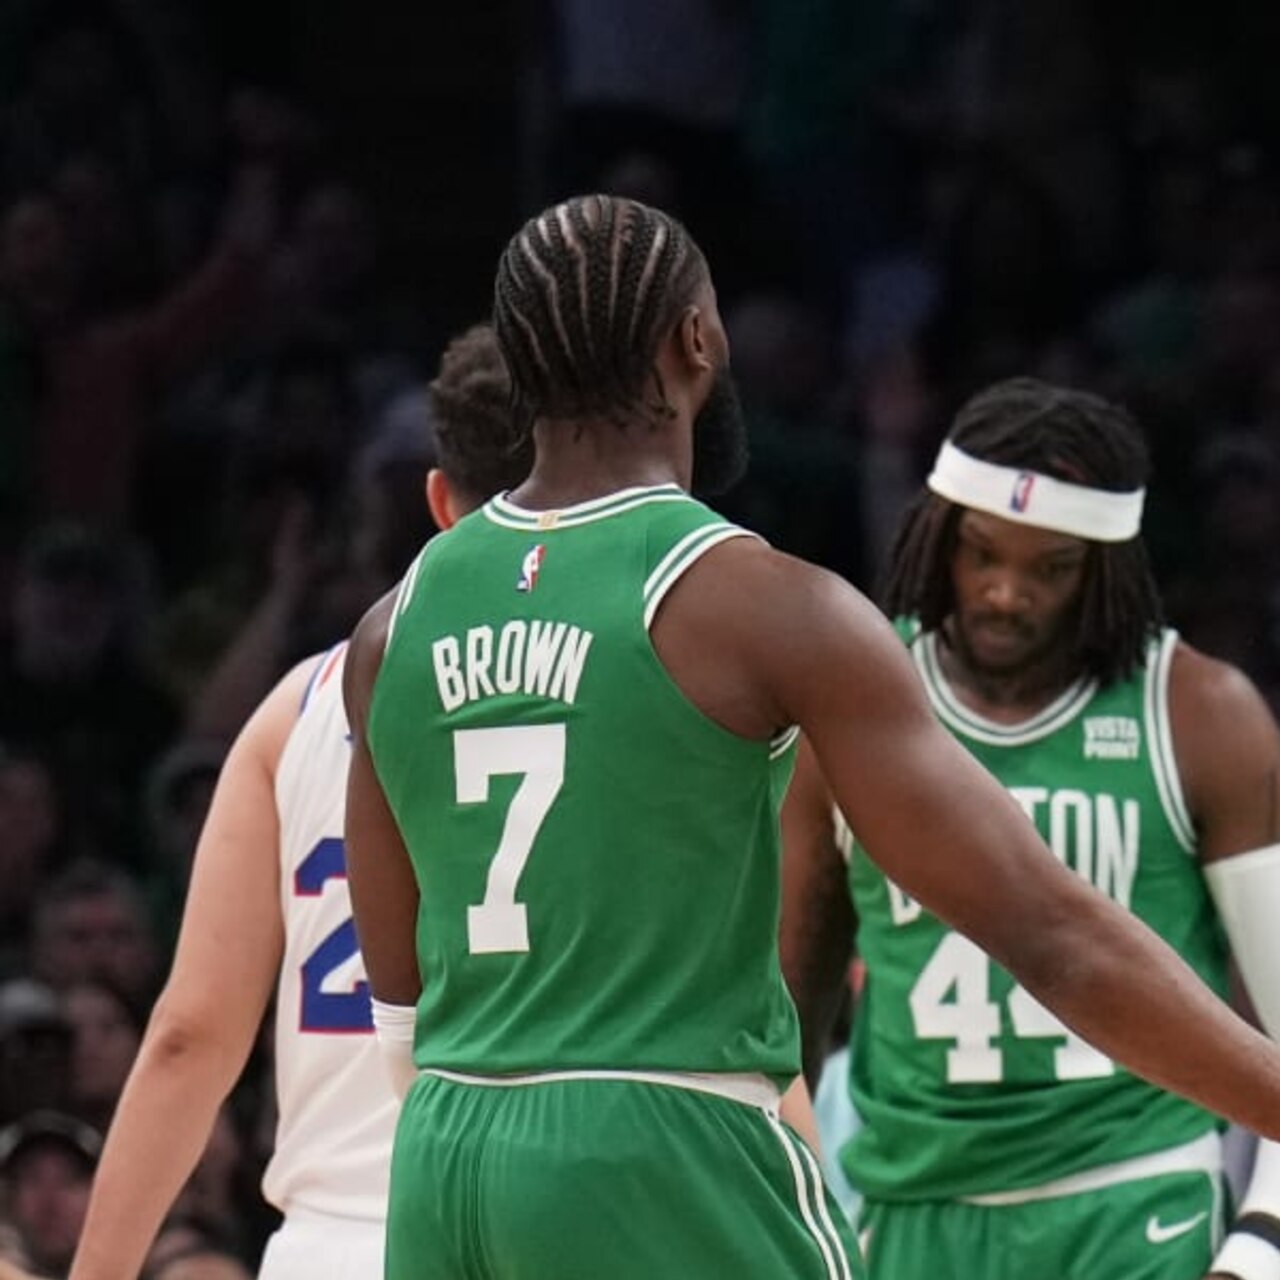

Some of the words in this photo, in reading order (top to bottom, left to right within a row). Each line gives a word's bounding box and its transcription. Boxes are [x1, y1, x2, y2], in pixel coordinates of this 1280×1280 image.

[433, 619, 593, 713] BROWN
[453, 723, 566, 955] 7
[910, 929, 1116, 1083] 44
